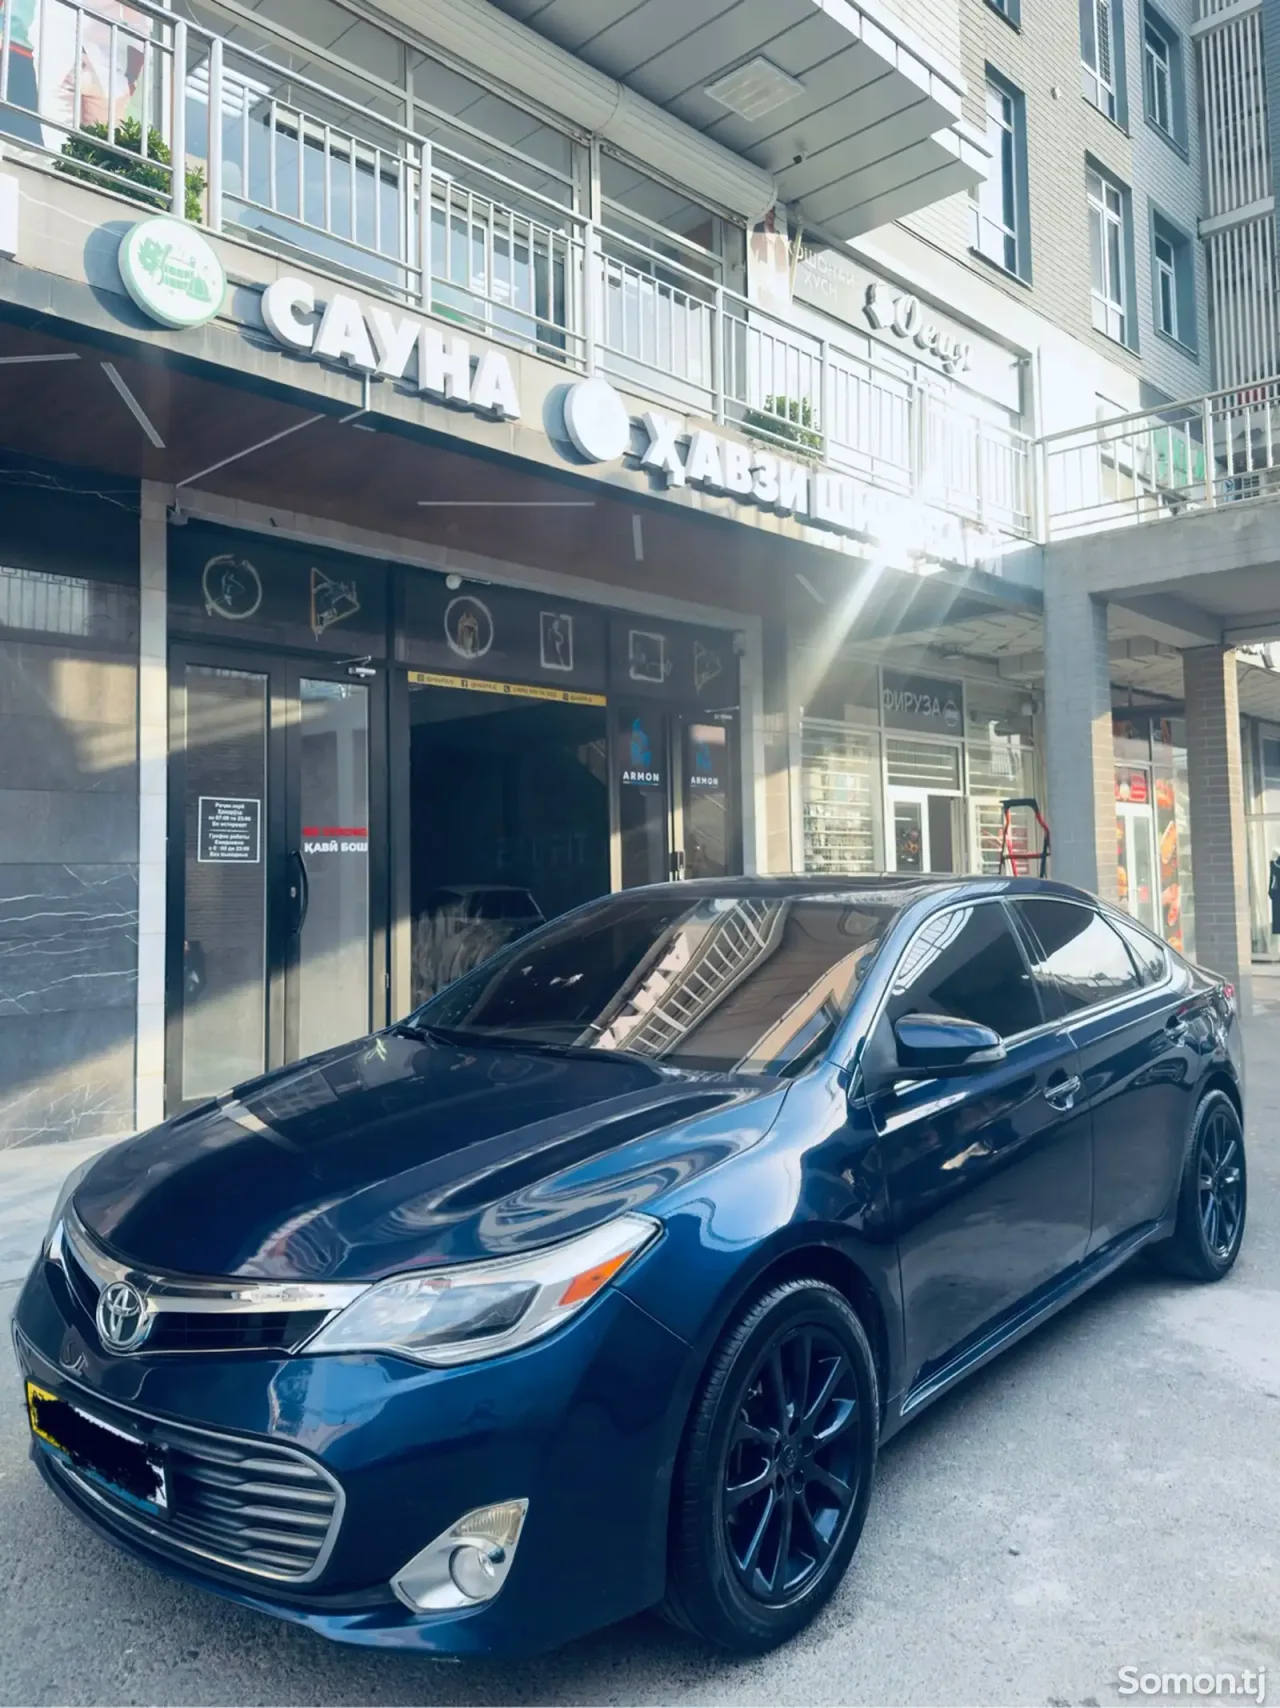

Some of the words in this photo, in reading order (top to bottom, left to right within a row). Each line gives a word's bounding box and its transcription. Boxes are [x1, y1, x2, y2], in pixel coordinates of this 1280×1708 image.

[261, 277, 520, 420] САУНА
[882, 687, 941, 717] ФИРУЗА
[622, 771, 660, 782] ARMON
[690, 776, 719, 785] ARMON
[340, 842, 368, 852] БОШ
